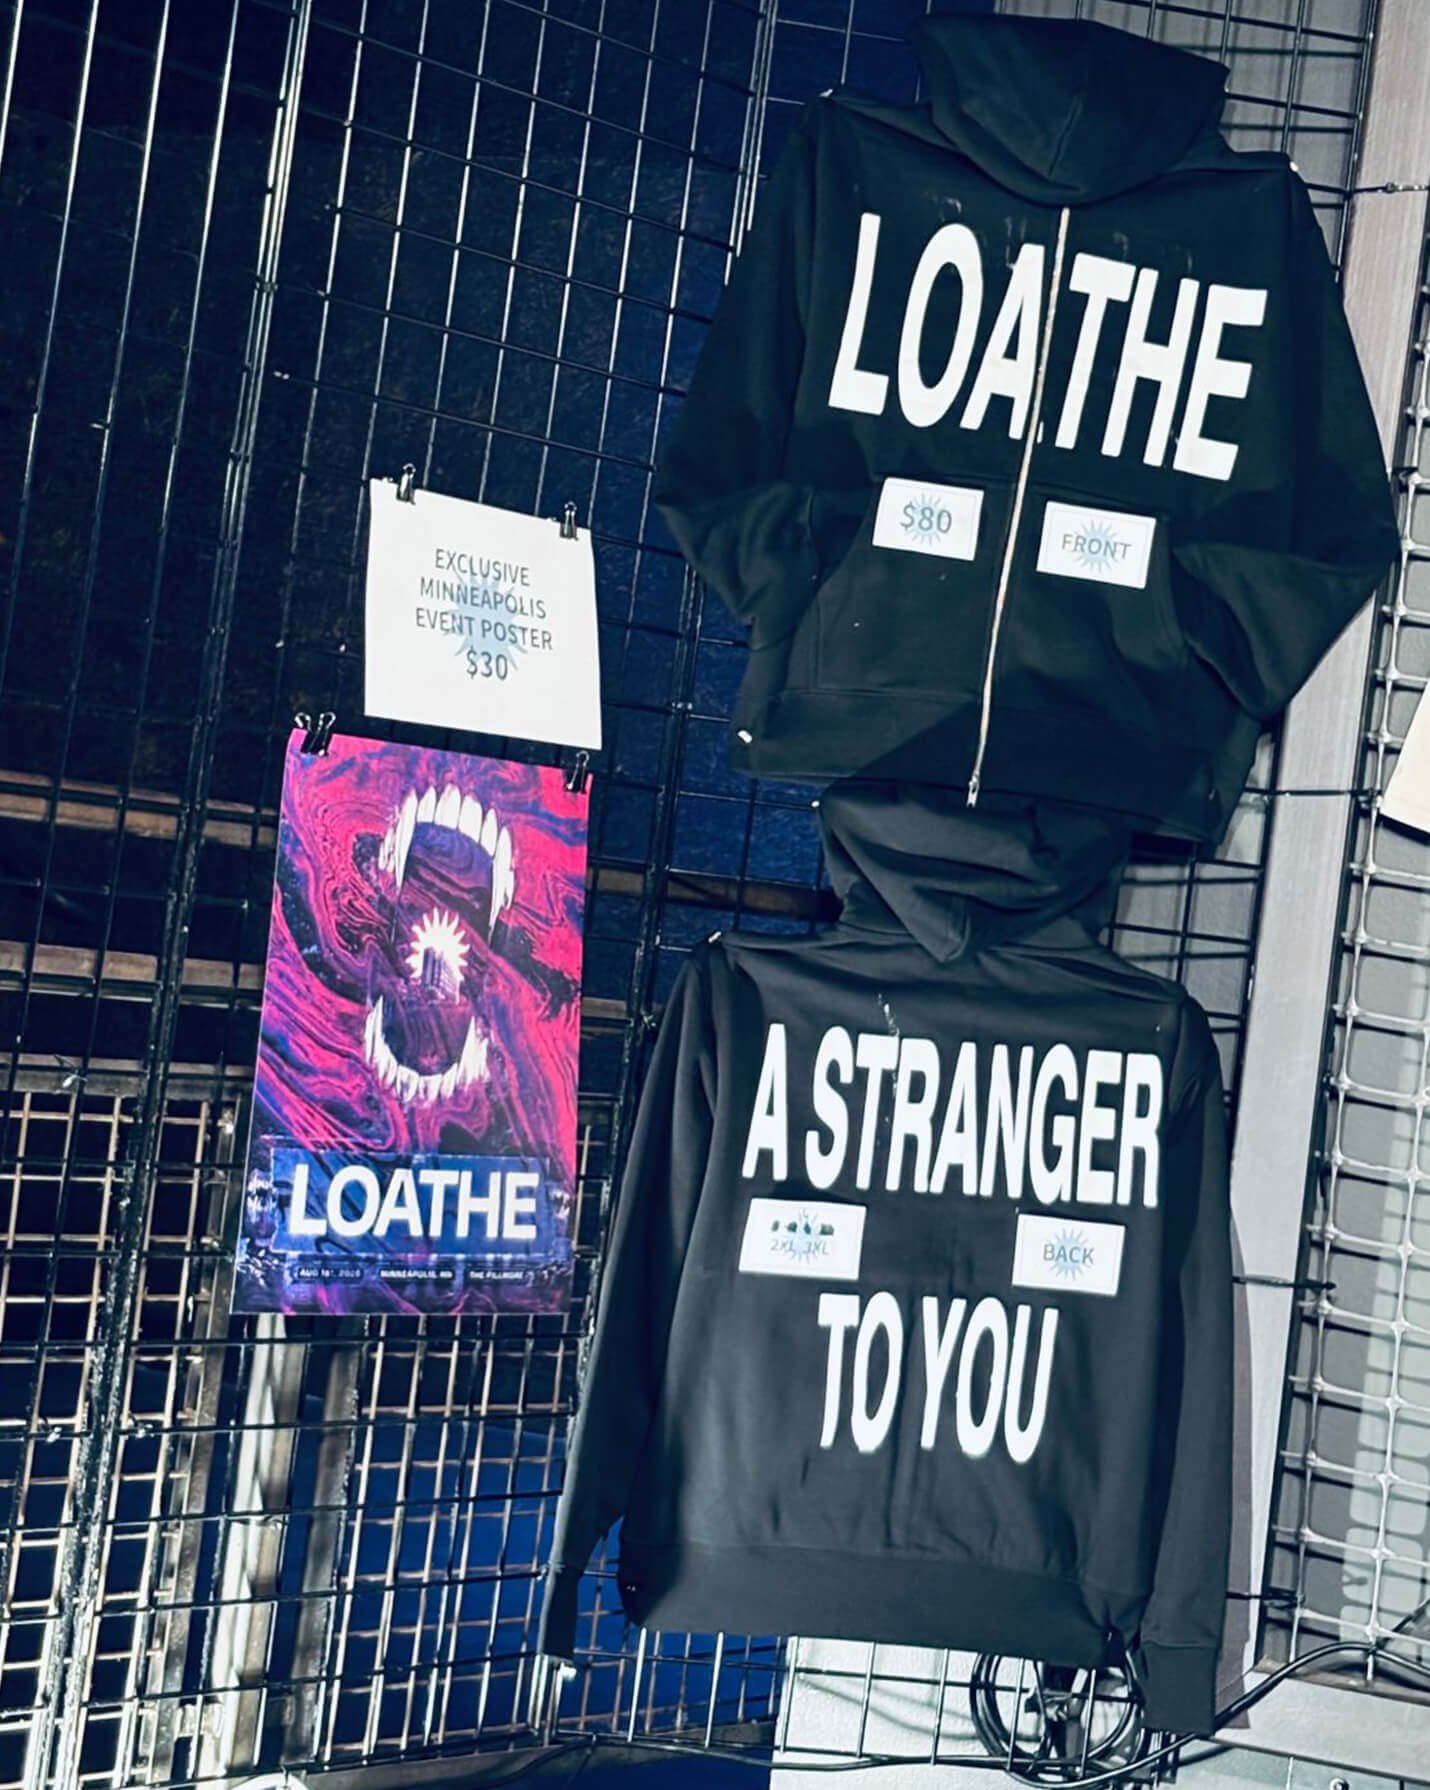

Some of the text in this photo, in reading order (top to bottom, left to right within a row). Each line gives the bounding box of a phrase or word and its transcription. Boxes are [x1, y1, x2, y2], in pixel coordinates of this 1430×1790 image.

[828, 212, 1268, 481] LOATHE
[899, 500, 953, 534] $80
[435, 547, 531, 586] EXCLUSIVE
[1061, 533, 1132, 561] FRONT
[419, 577, 547, 620] MINNEAPOLIS
[415, 607, 553, 651] EVENT POSTER
[466, 645, 509, 681] $30
[742, 1023, 1164, 1208] A STRANGER
[287, 1163, 540, 1240] LOATHE
[1043, 1243, 1095, 1266] BACK
[817, 1291, 1060, 1464] TO YOU
